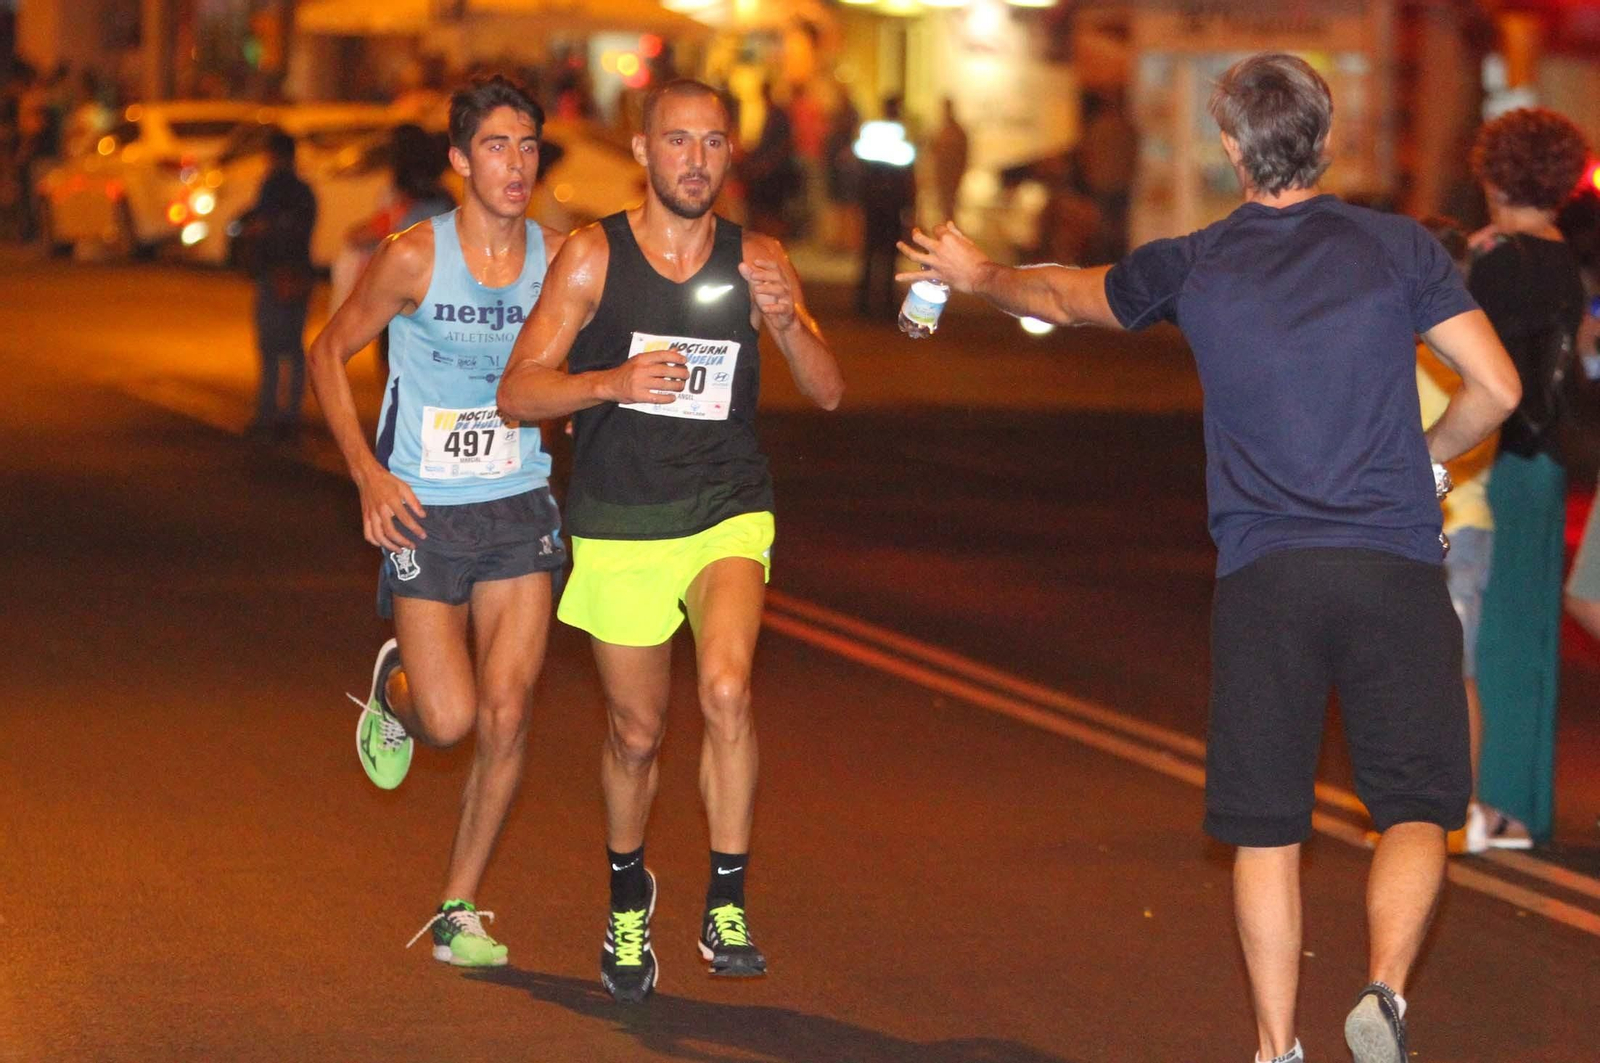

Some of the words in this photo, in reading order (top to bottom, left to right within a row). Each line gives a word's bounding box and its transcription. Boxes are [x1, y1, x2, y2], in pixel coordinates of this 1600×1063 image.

[433, 300, 524, 331] nerja
[445, 331, 514, 343] ATLETISMO
[669, 341, 728, 355] NOCTURNA
[444, 430, 495, 457] 497
